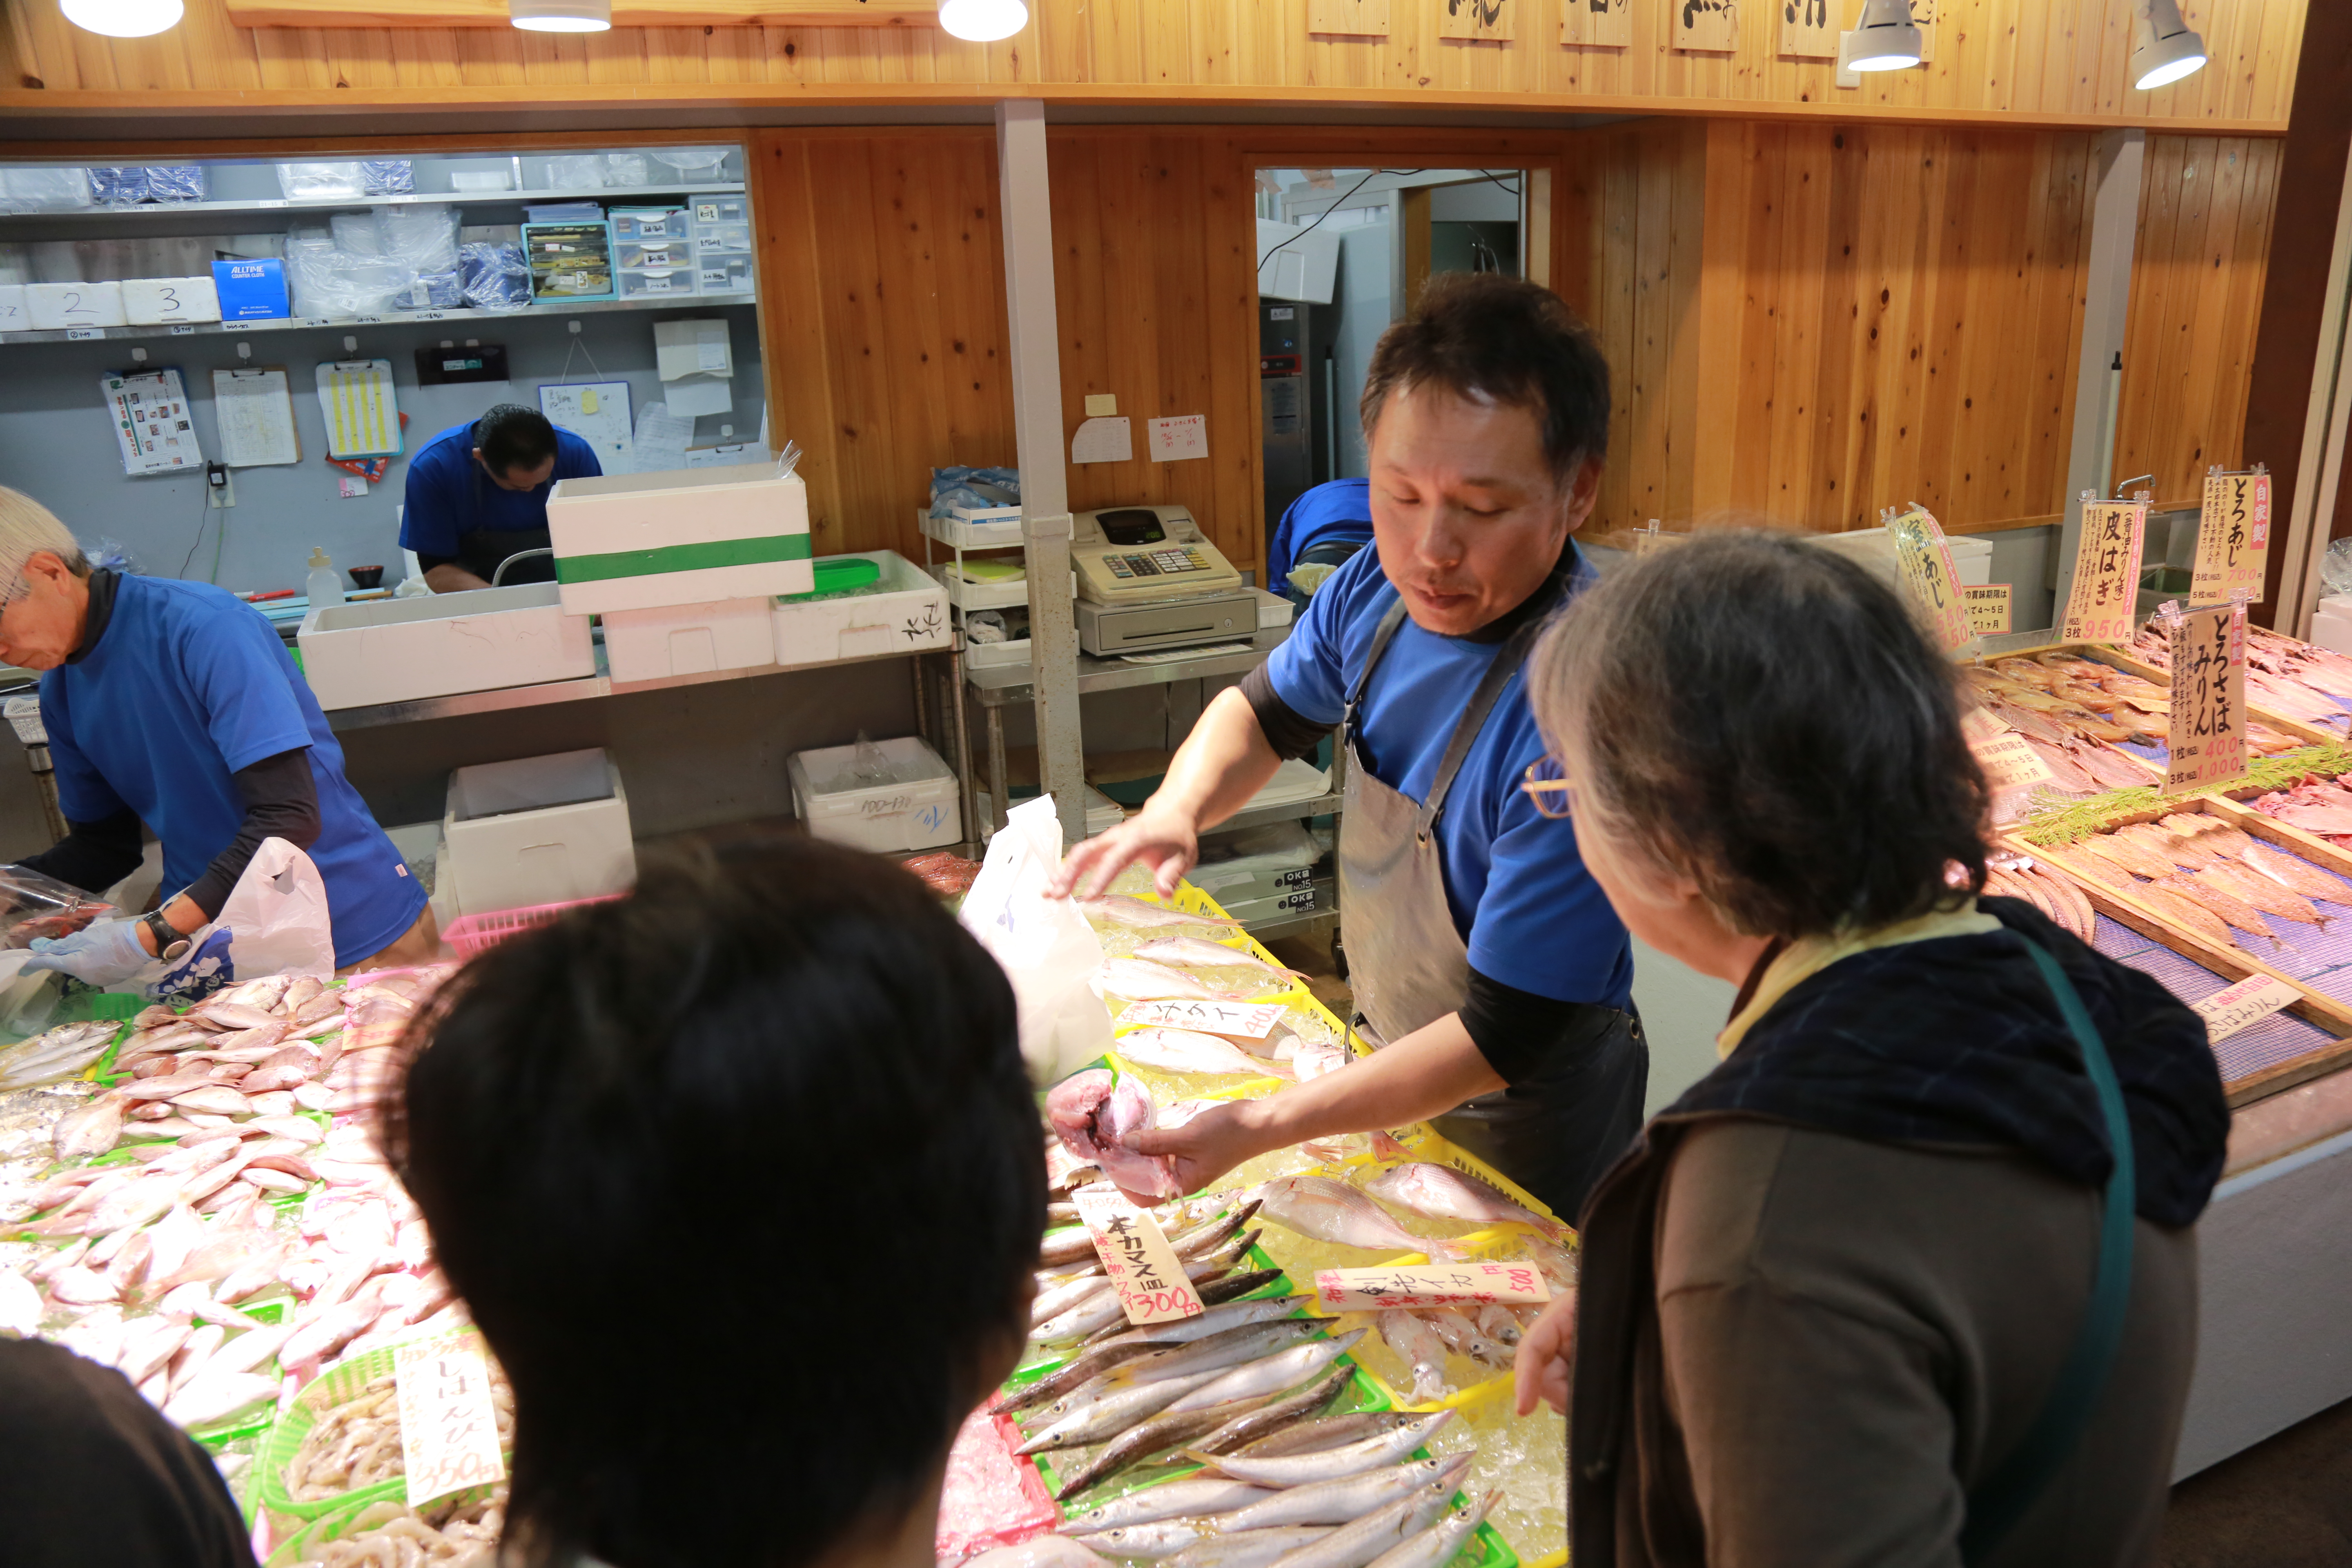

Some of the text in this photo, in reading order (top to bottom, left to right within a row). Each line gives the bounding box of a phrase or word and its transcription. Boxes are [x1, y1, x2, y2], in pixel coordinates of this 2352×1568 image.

[64, 293, 100, 313] 2
[160, 287, 180, 311] 3
[2228, 478, 2247, 567] とろあじ
[2253, 483, 2267, 543] 自家製
[1907, 519, 1944, 608] 室あじ
[2096, 511, 2122, 606] 皮はぎ
[1965, 589, 2007, 599] の賞味期限は
[2065, 627, 2081, 638] 3枚
[2232, 614, 2243, 662] 自家製
[2194, 644, 2212, 736] みりん
[2212, 614, 2232, 736] とろさば
[1976, 740, 2025, 756] の賞味期限は
[2214, 976, 2274, 1006] 組合せ自由
[1106, 1213, 1158, 1278] 本カマス
[1354, 1273, 1474, 1296] 剣先イカ
[1507, 1269, 1536, 1294] 500
[1132, 1286, 1201, 1318] 300円
[415, 1452, 501, 1498] 350円
